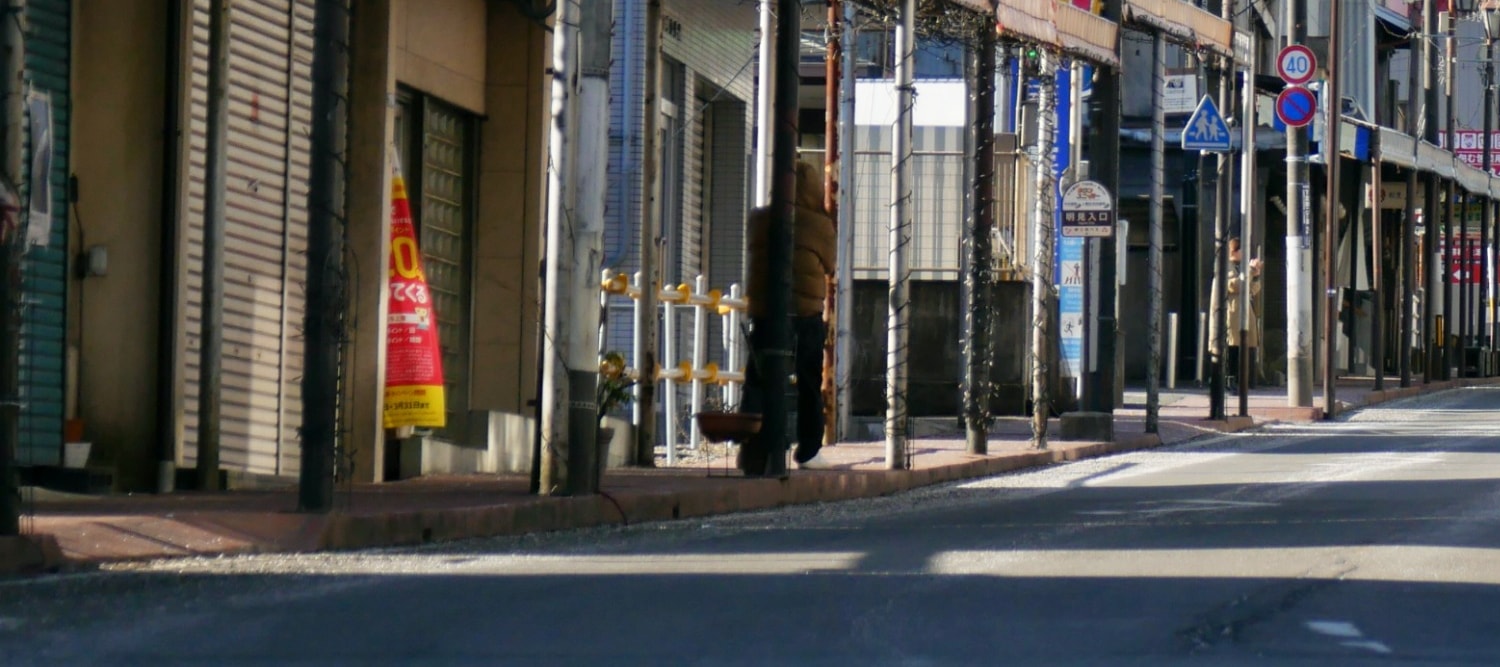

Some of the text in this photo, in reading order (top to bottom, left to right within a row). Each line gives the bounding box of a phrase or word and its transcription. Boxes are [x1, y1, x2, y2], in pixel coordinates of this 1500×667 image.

[1286, 56, 1307, 73] 40
[1065, 212, 1109, 222] 明見入口
